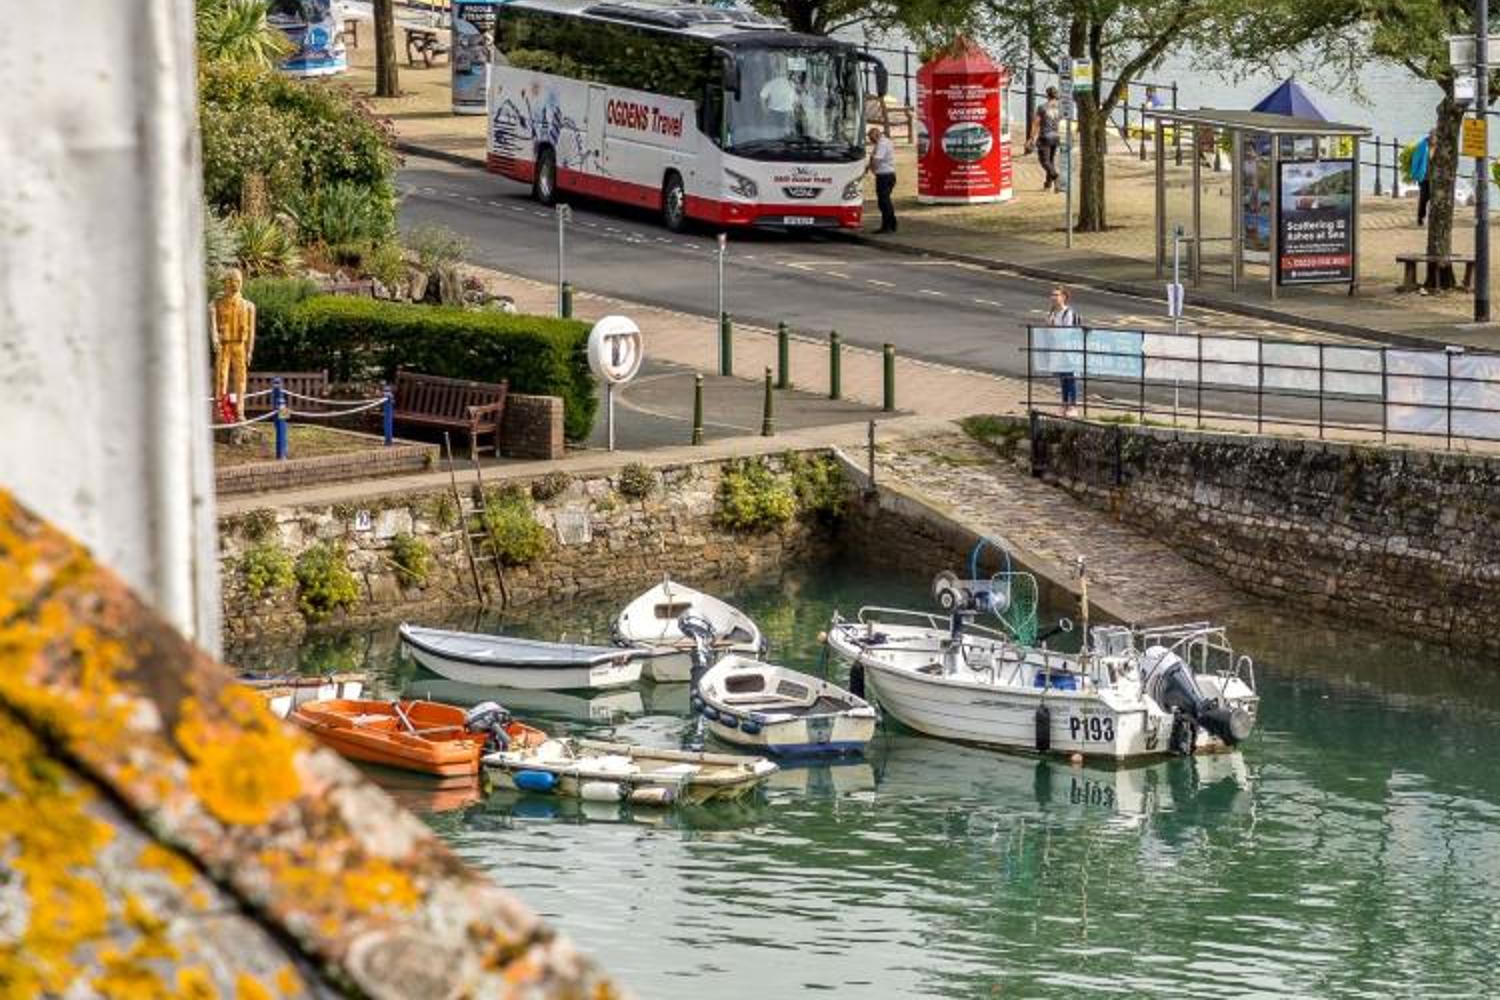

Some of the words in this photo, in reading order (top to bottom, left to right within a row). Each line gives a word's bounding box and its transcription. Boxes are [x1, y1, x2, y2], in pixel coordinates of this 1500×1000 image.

[607, 99, 648, 131] OGDENS
[651, 106, 684, 138] Travel
[1287, 220, 1335, 232] Scattering
[1287, 231, 1314, 240] Ashes
[1327, 229, 1345, 239] Sea
[1069, 716, 1116, 742] P193
